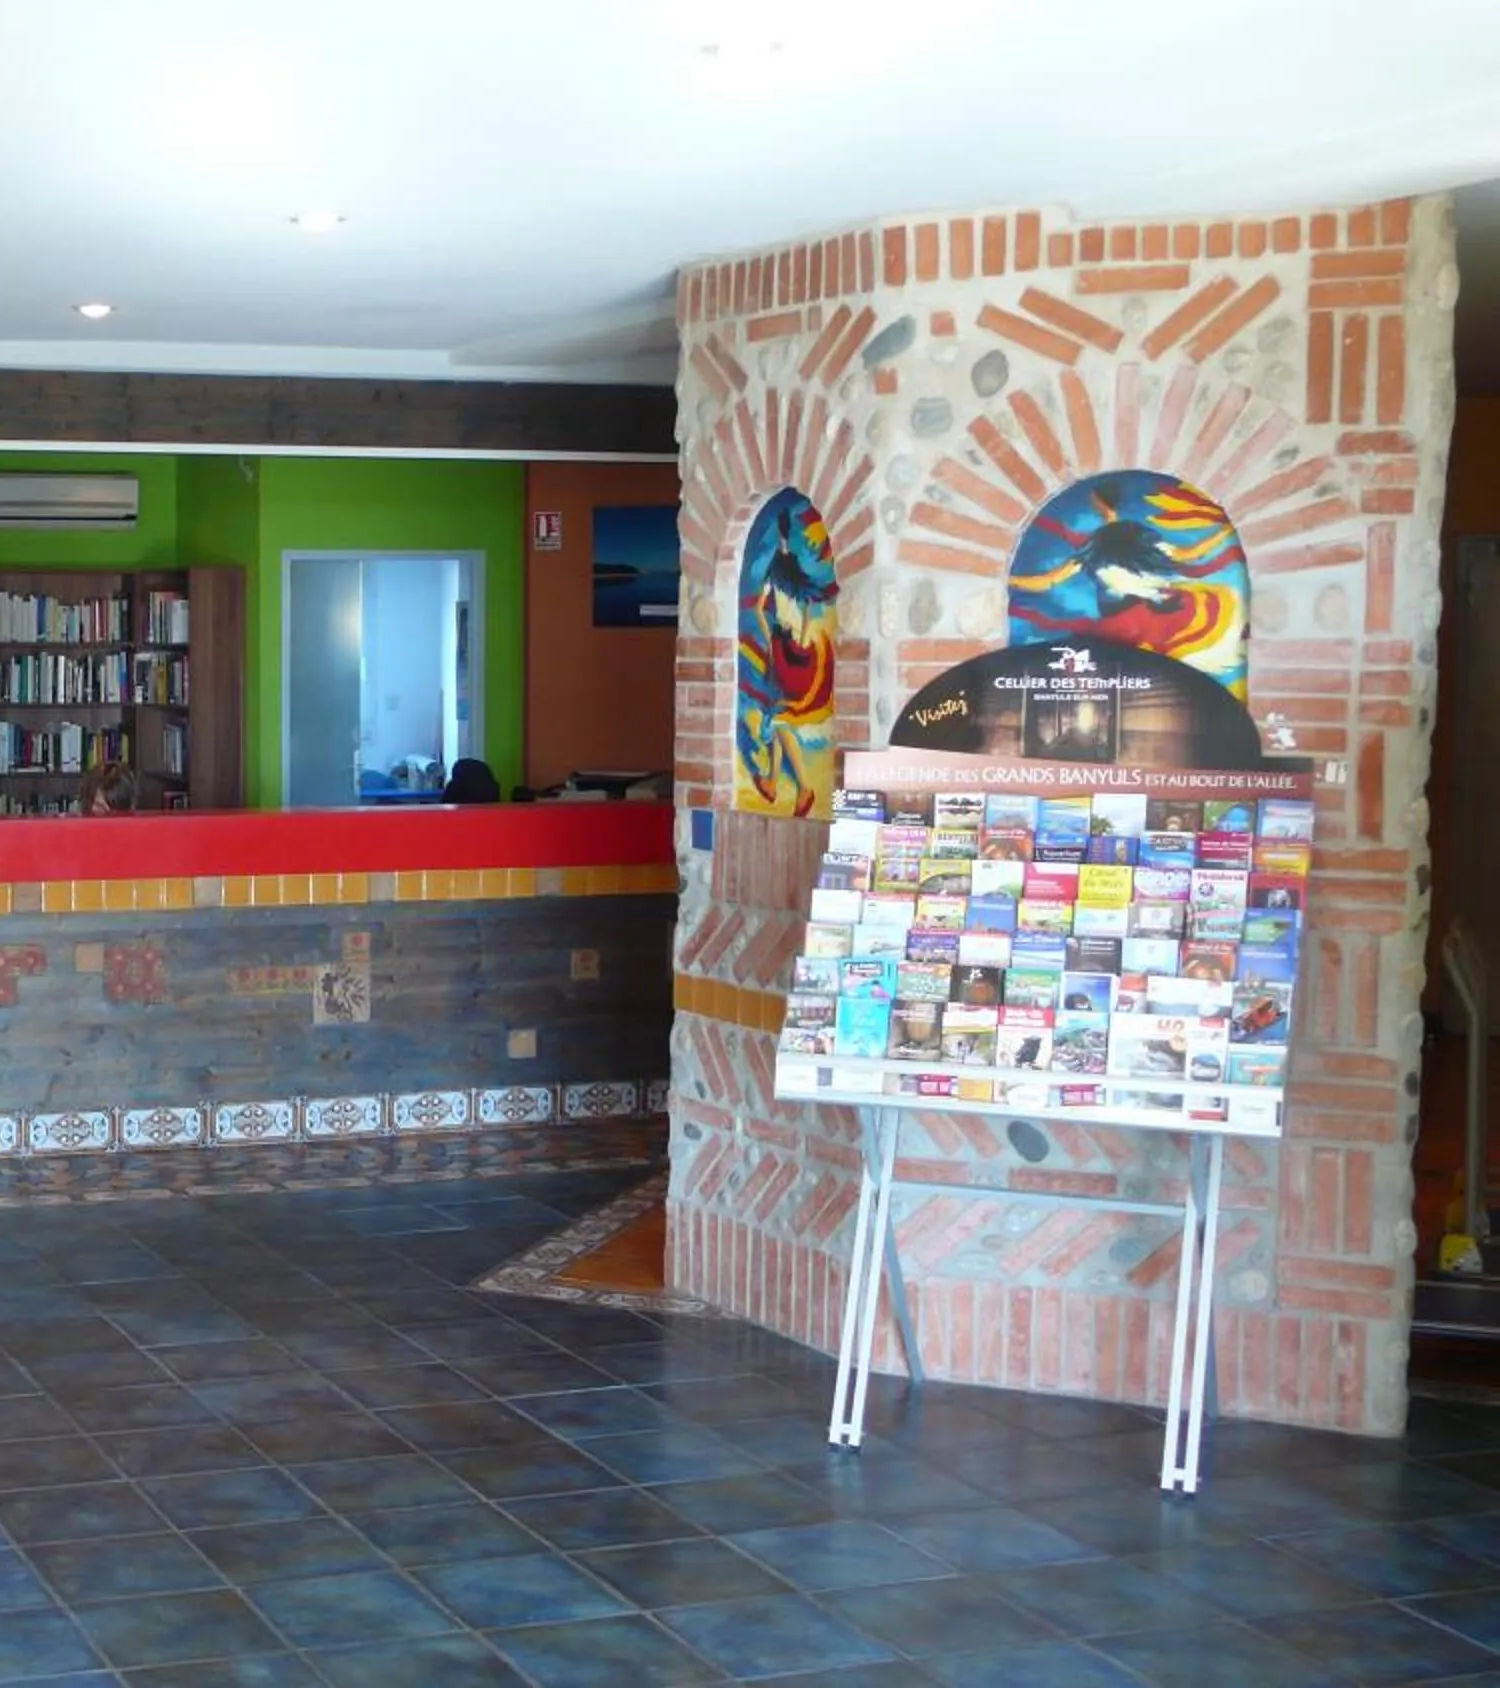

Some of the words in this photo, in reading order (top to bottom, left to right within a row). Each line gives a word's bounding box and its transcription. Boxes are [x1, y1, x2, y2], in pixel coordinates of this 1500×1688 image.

[1050, 676, 1076, 689] DES
[981, 766, 1055, 784] GRANDS
[1058, 767, 1142, 785] BANYULS
[1145, 774, 1167, 786] EST
[1167, 774, 1188, 786] AU
[1189, 774, 1227, 788] BOUT
[1228, 775, 1245, 788] DE
